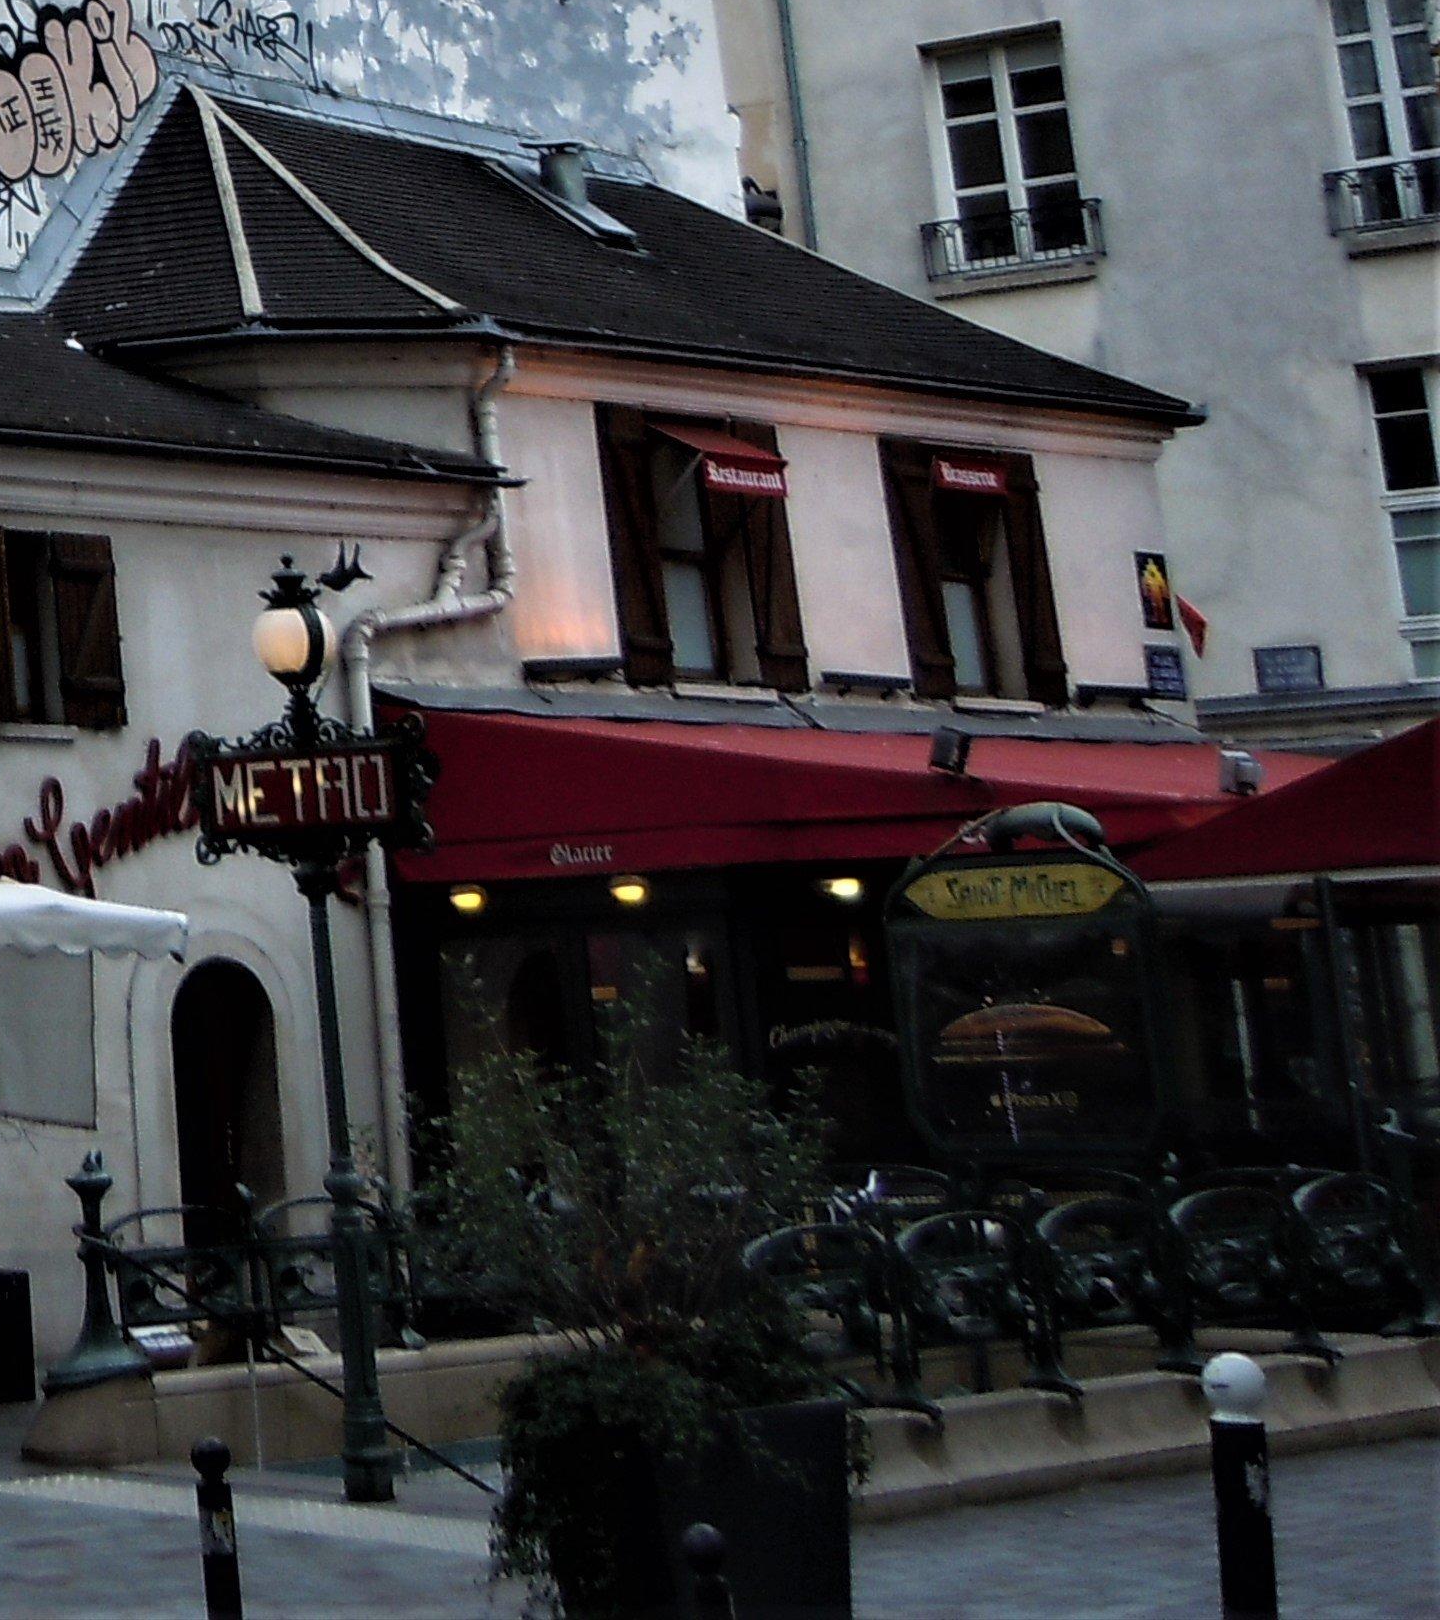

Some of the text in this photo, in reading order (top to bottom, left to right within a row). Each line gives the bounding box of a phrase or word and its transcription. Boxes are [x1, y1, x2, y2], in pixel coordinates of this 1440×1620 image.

[705, 459, 783, 490] Restaurant
[212, 754, 388, 825] METRO
[549, 842, 613, 866] Glacier
